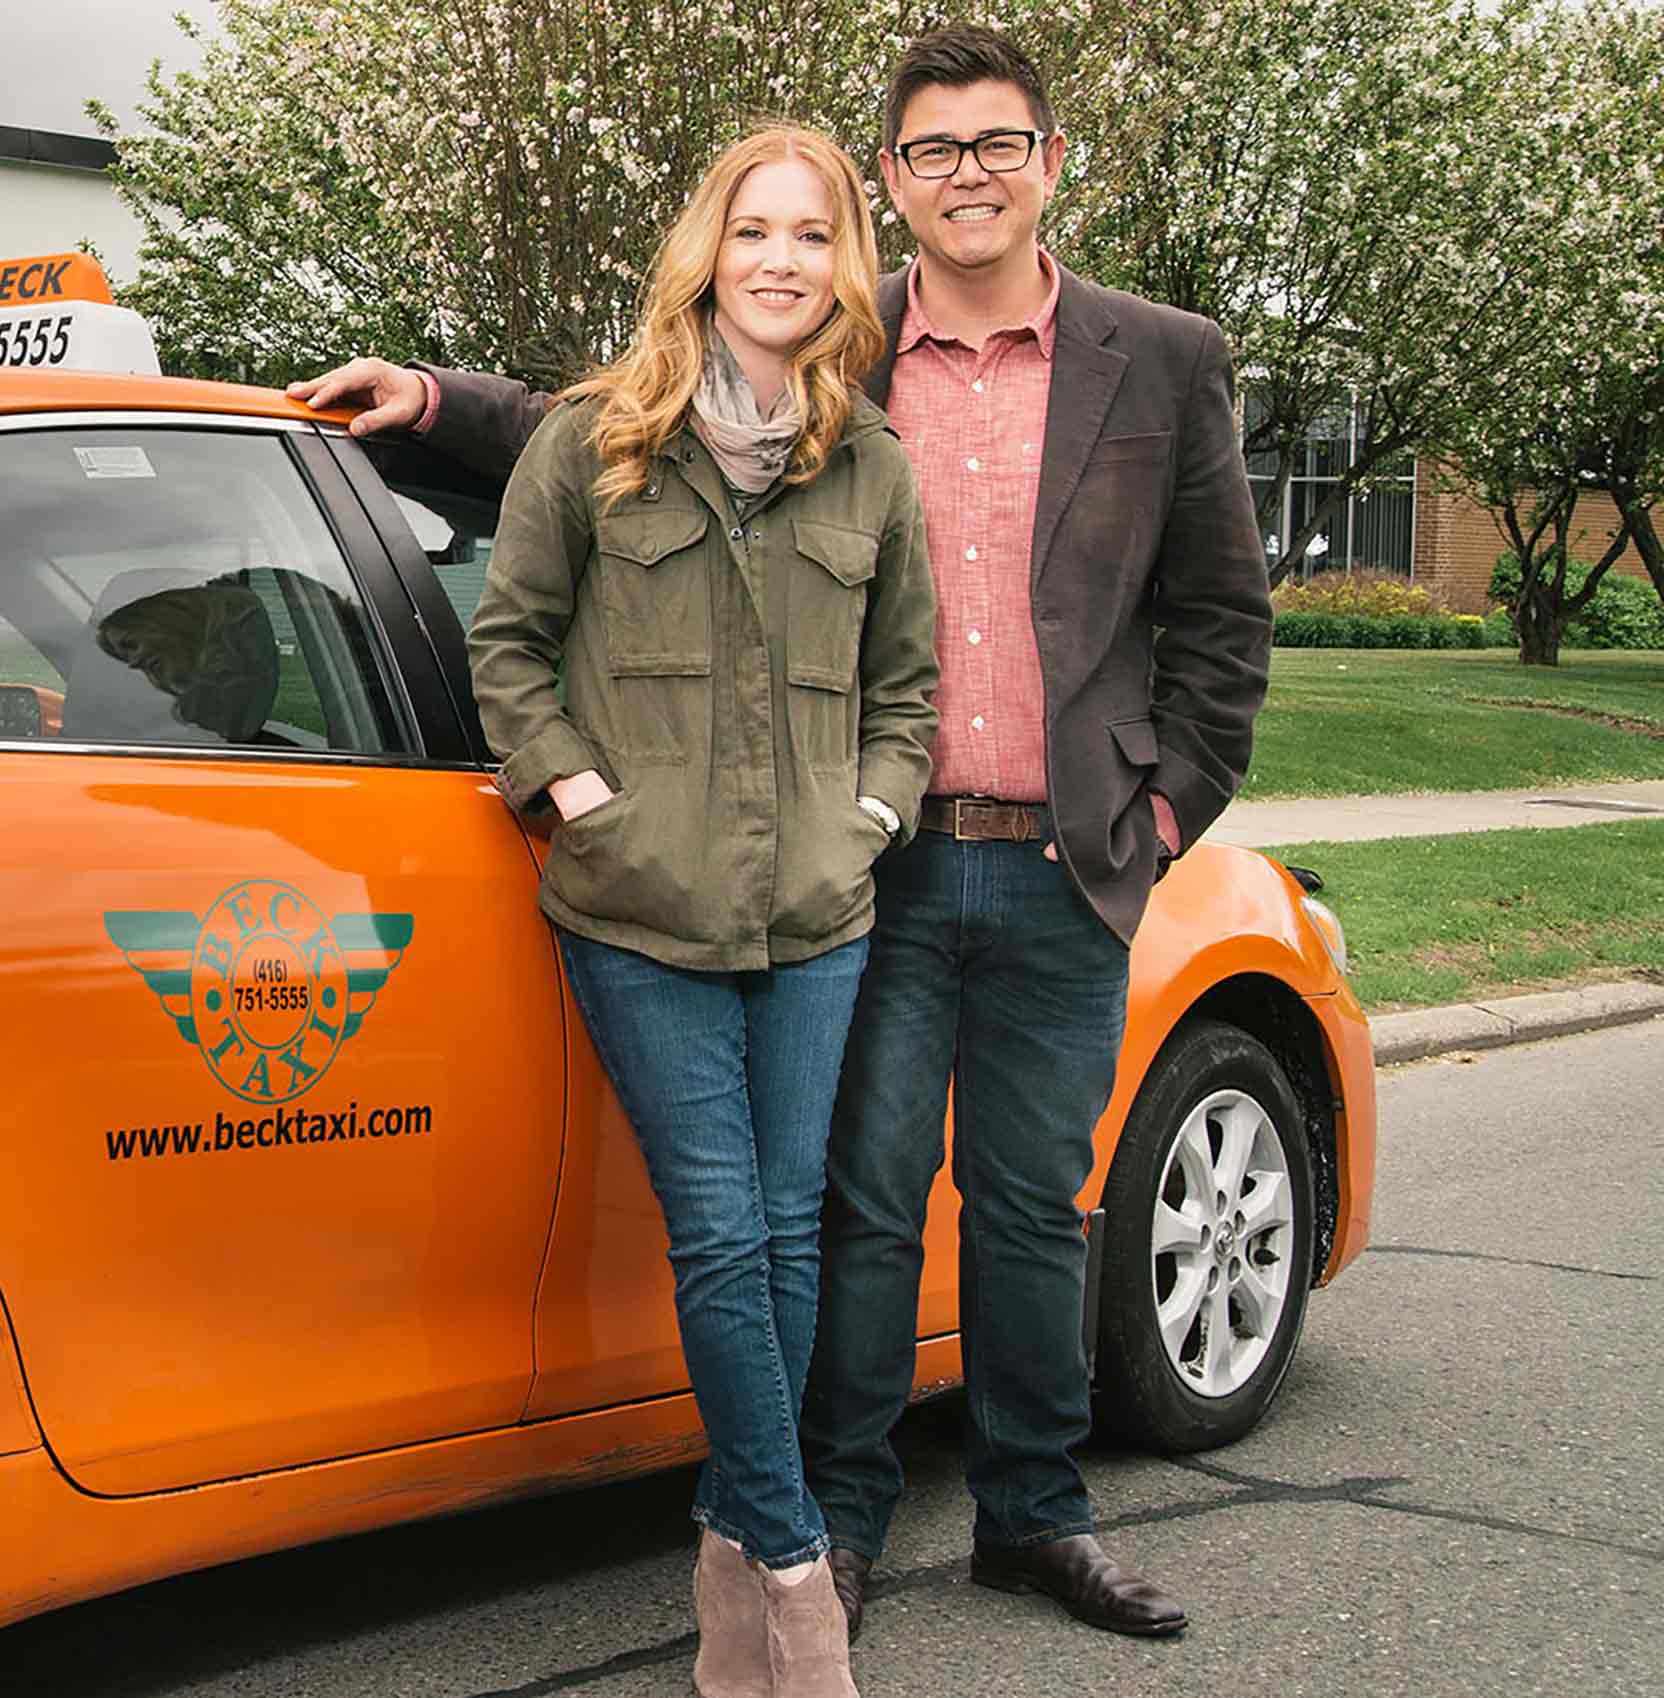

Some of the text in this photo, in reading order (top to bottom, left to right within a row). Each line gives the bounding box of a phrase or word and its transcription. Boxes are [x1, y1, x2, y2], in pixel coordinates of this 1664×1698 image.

[199, 890, 340, 981] BECK
[234, 986, 309, 1012] 751-5555
[253, 959, 288, 983] (416)
[208, 1010, 340, 1097] TAXI
[106, 1102, 432, 1160] www.becktaxi.com
